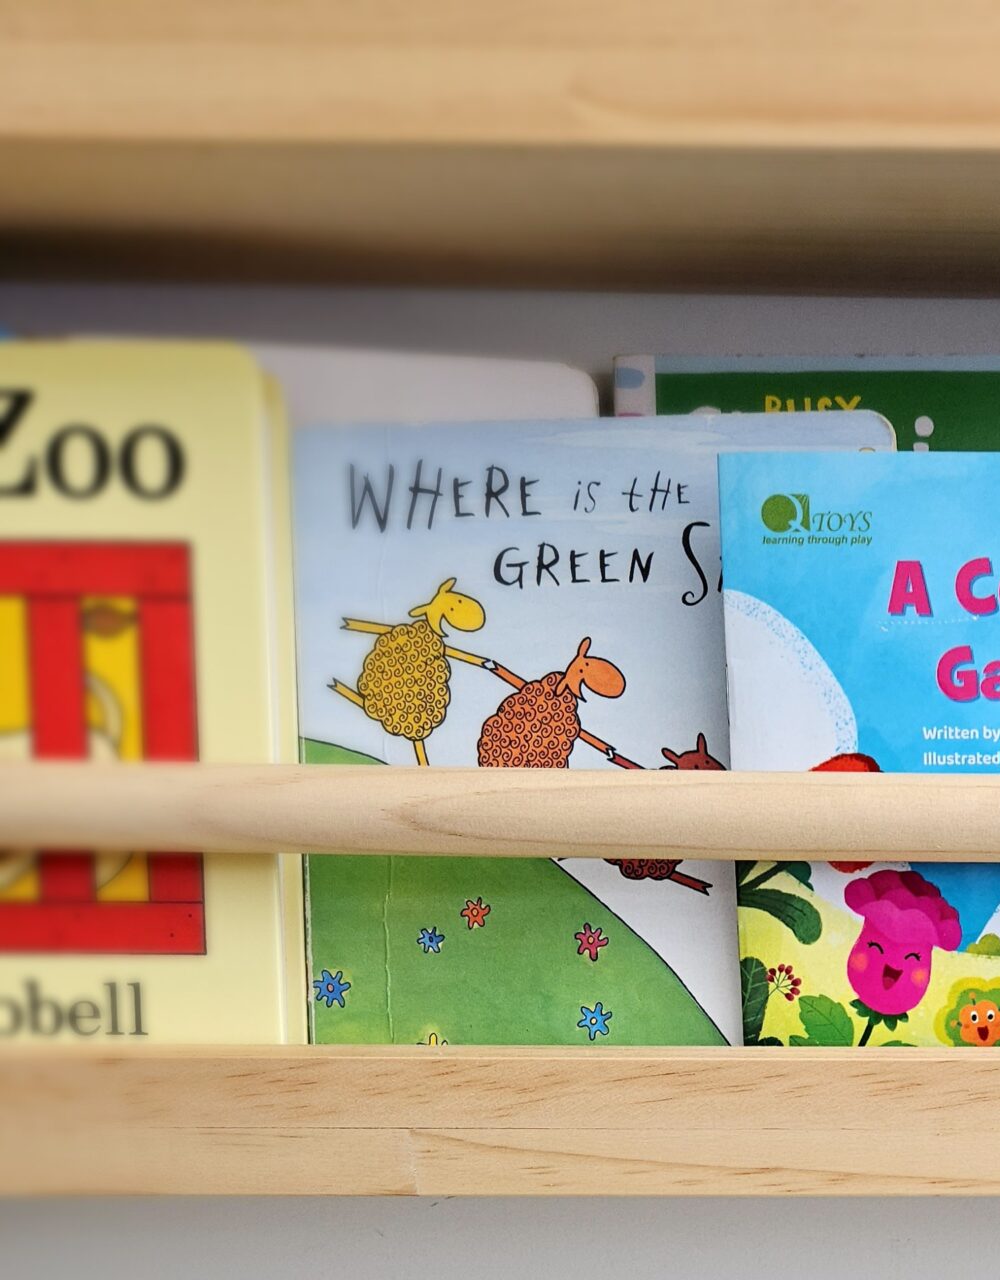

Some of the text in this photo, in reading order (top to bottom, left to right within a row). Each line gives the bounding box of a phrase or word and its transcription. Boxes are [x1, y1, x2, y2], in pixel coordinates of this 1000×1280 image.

[348, 458, 542, 534] WHERE
[573, 479, 601, 514] is
[762, 534, 873, 547] learning through play
[492, 520, 723, 607] GREEN S
[886, 560, 935, 617] A
[922, 724, 980, 741] Written
[922, 750, 1000, 766] Illustrated
